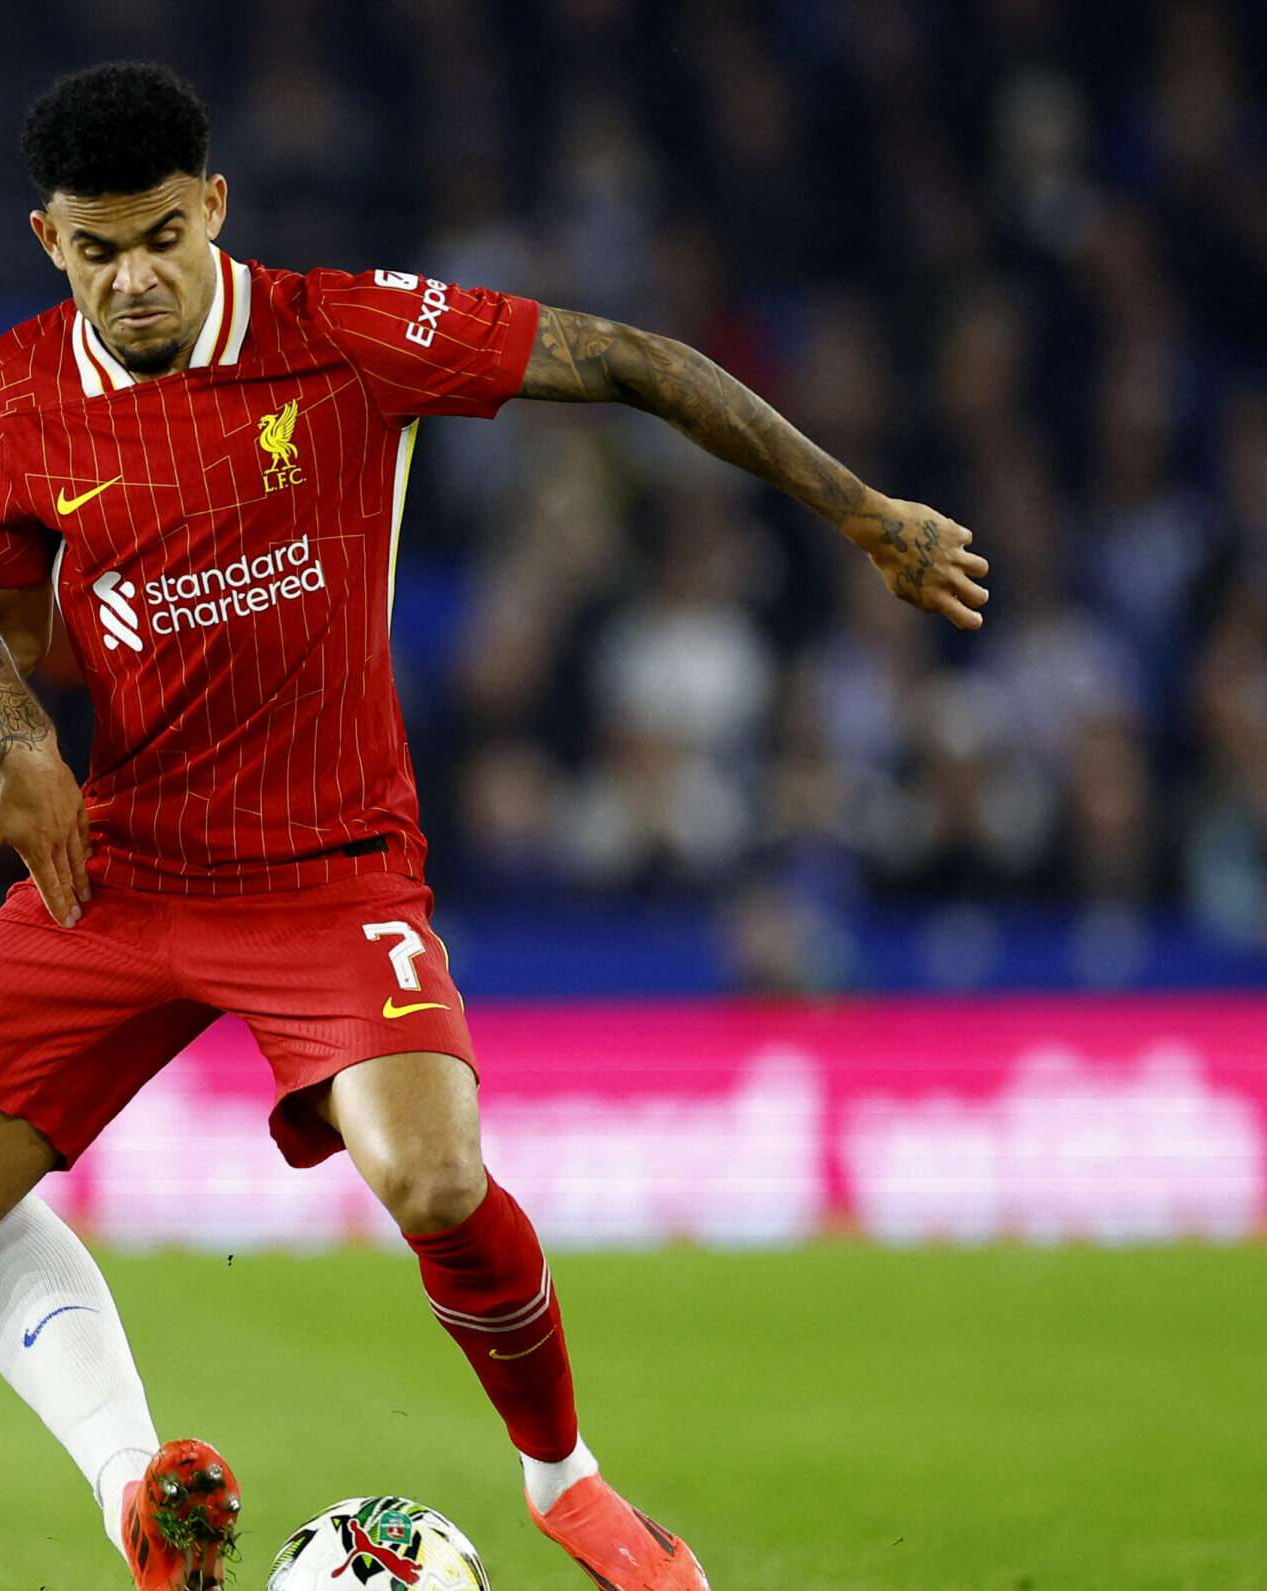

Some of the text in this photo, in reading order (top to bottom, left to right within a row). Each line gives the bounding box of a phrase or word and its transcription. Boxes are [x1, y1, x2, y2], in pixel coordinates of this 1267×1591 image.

[263, 467, 307, 493] L.F.C.
[145, 533, 310, 605] standard
[152, 560, 326, 635] chartered
[361, 920, 426, 992] 7
